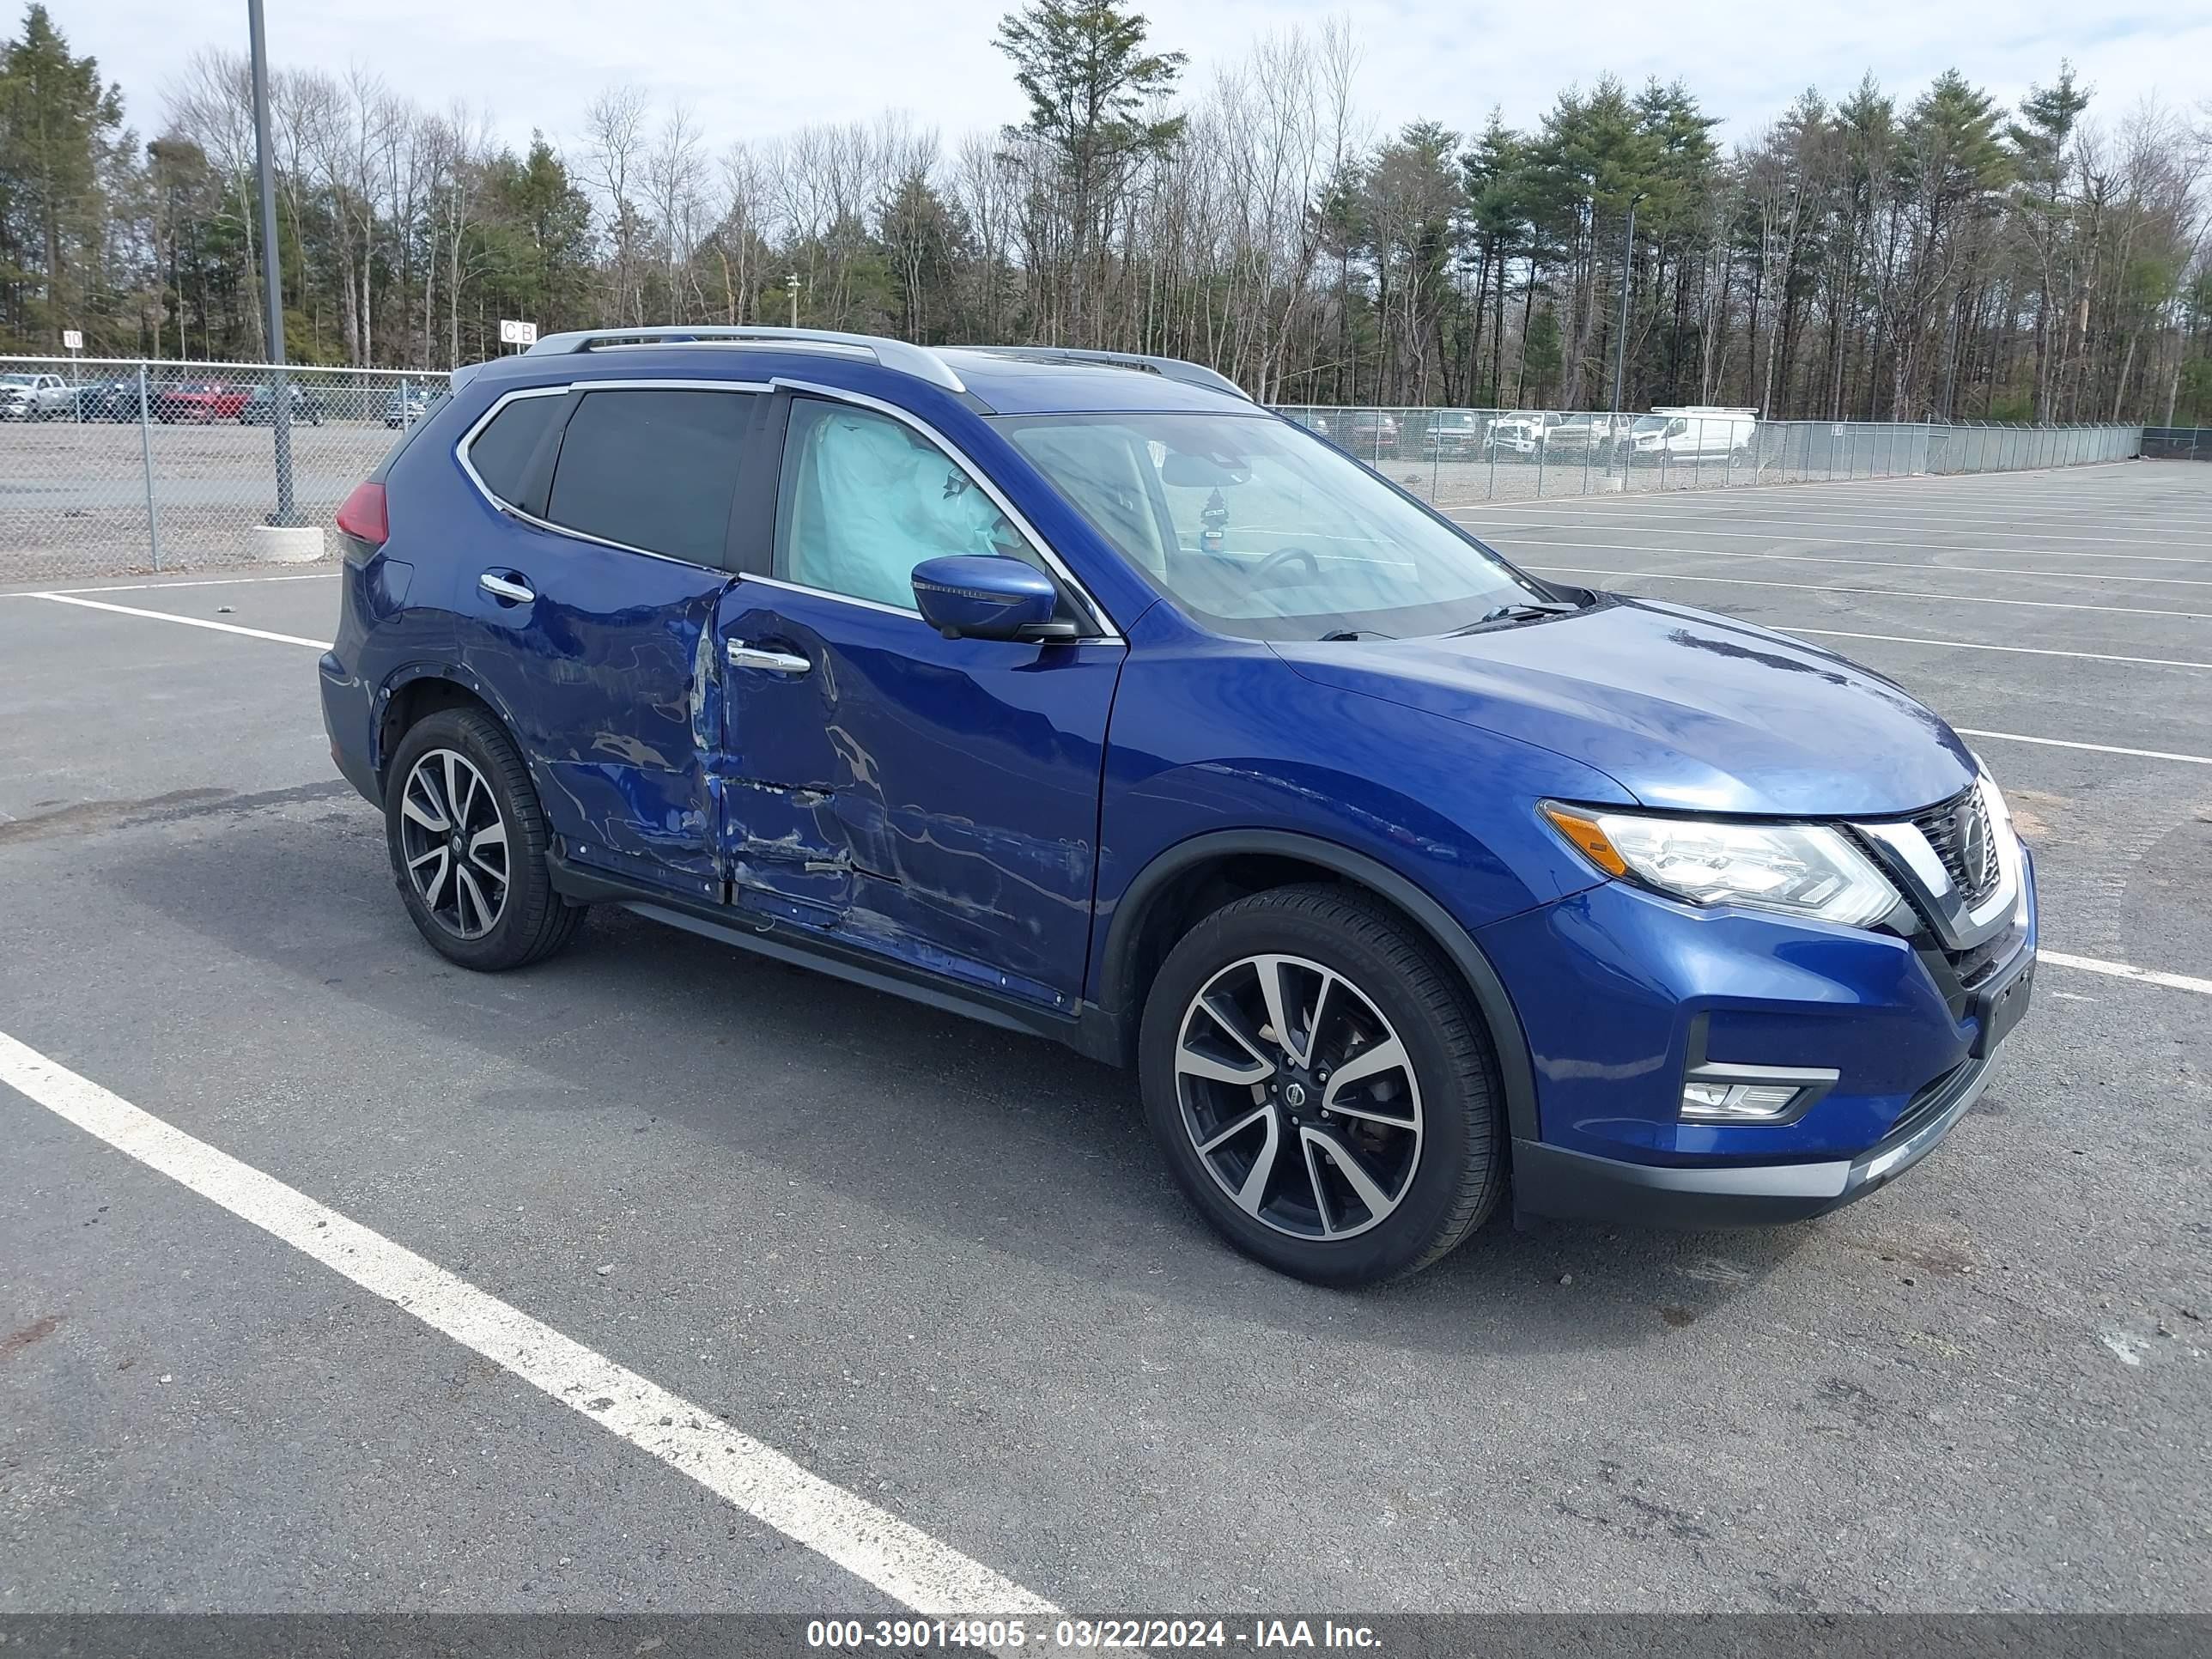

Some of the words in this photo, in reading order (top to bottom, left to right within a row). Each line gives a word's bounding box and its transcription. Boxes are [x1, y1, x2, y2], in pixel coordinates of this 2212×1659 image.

[64, 333, 81, 345] 10
[505, 323, 515, 339] C
[522, 325, 532, 341] B
